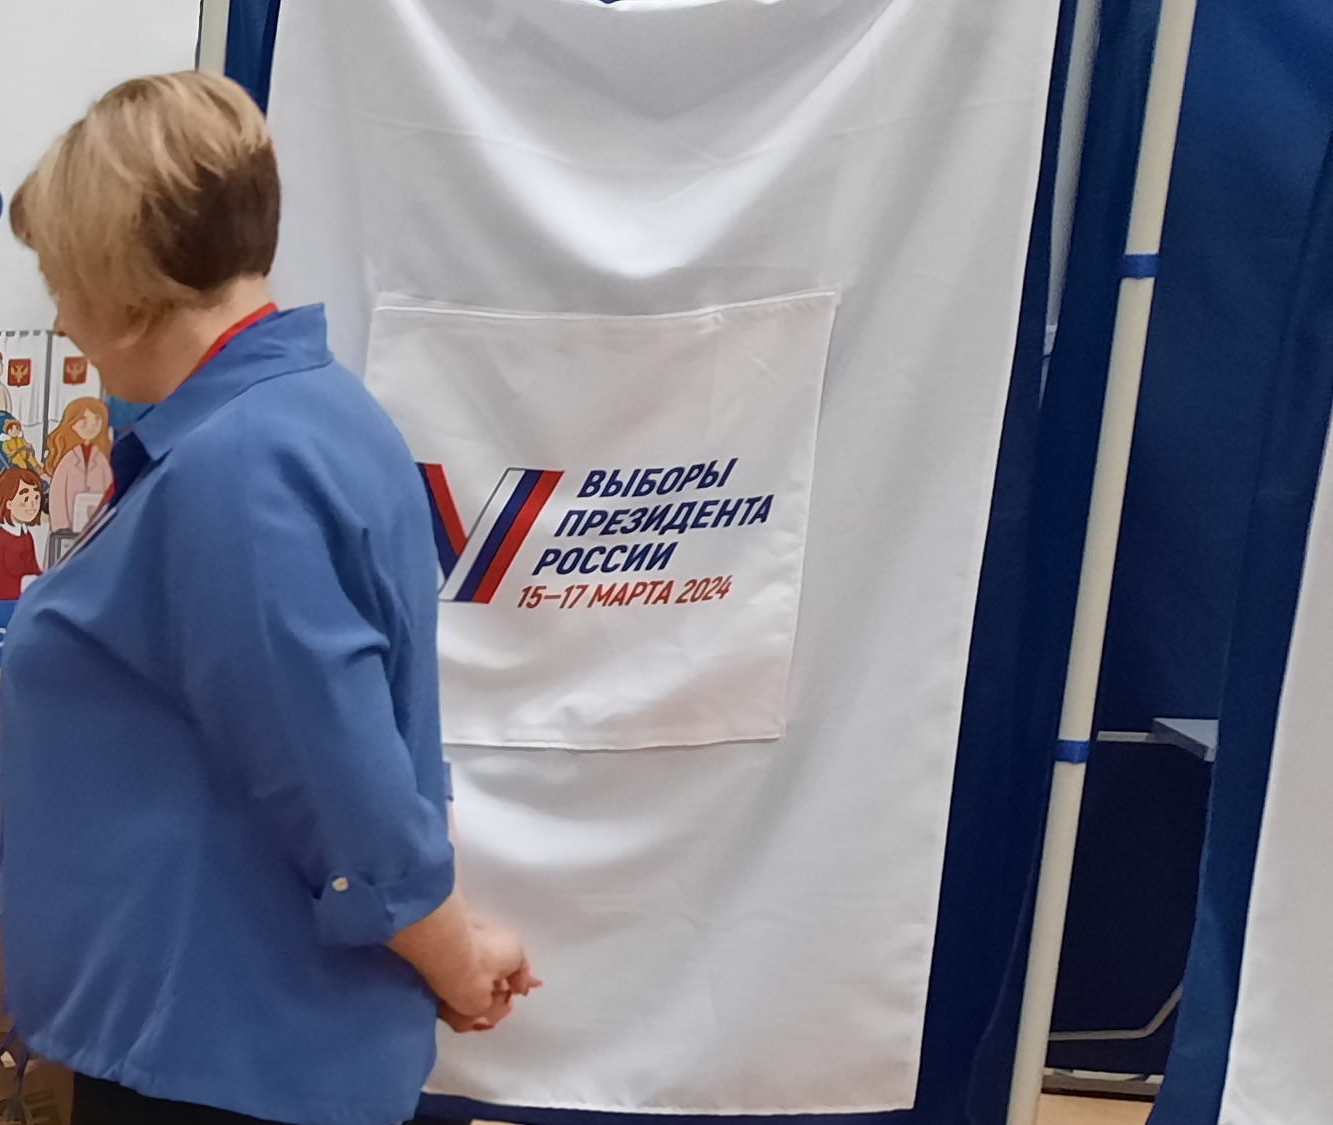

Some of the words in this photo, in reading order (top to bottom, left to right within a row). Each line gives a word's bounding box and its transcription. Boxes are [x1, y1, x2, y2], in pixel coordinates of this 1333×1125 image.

[577, 457, 739, 498] ВЫБОРЫ
[553, 494, 775, 538] ПРЕЗИДЕНТА
[531, 541, 679, 576] РОССИИ
[587, 579, 675, 609] МАРТА
[674, 575, 733, 604] 2024
